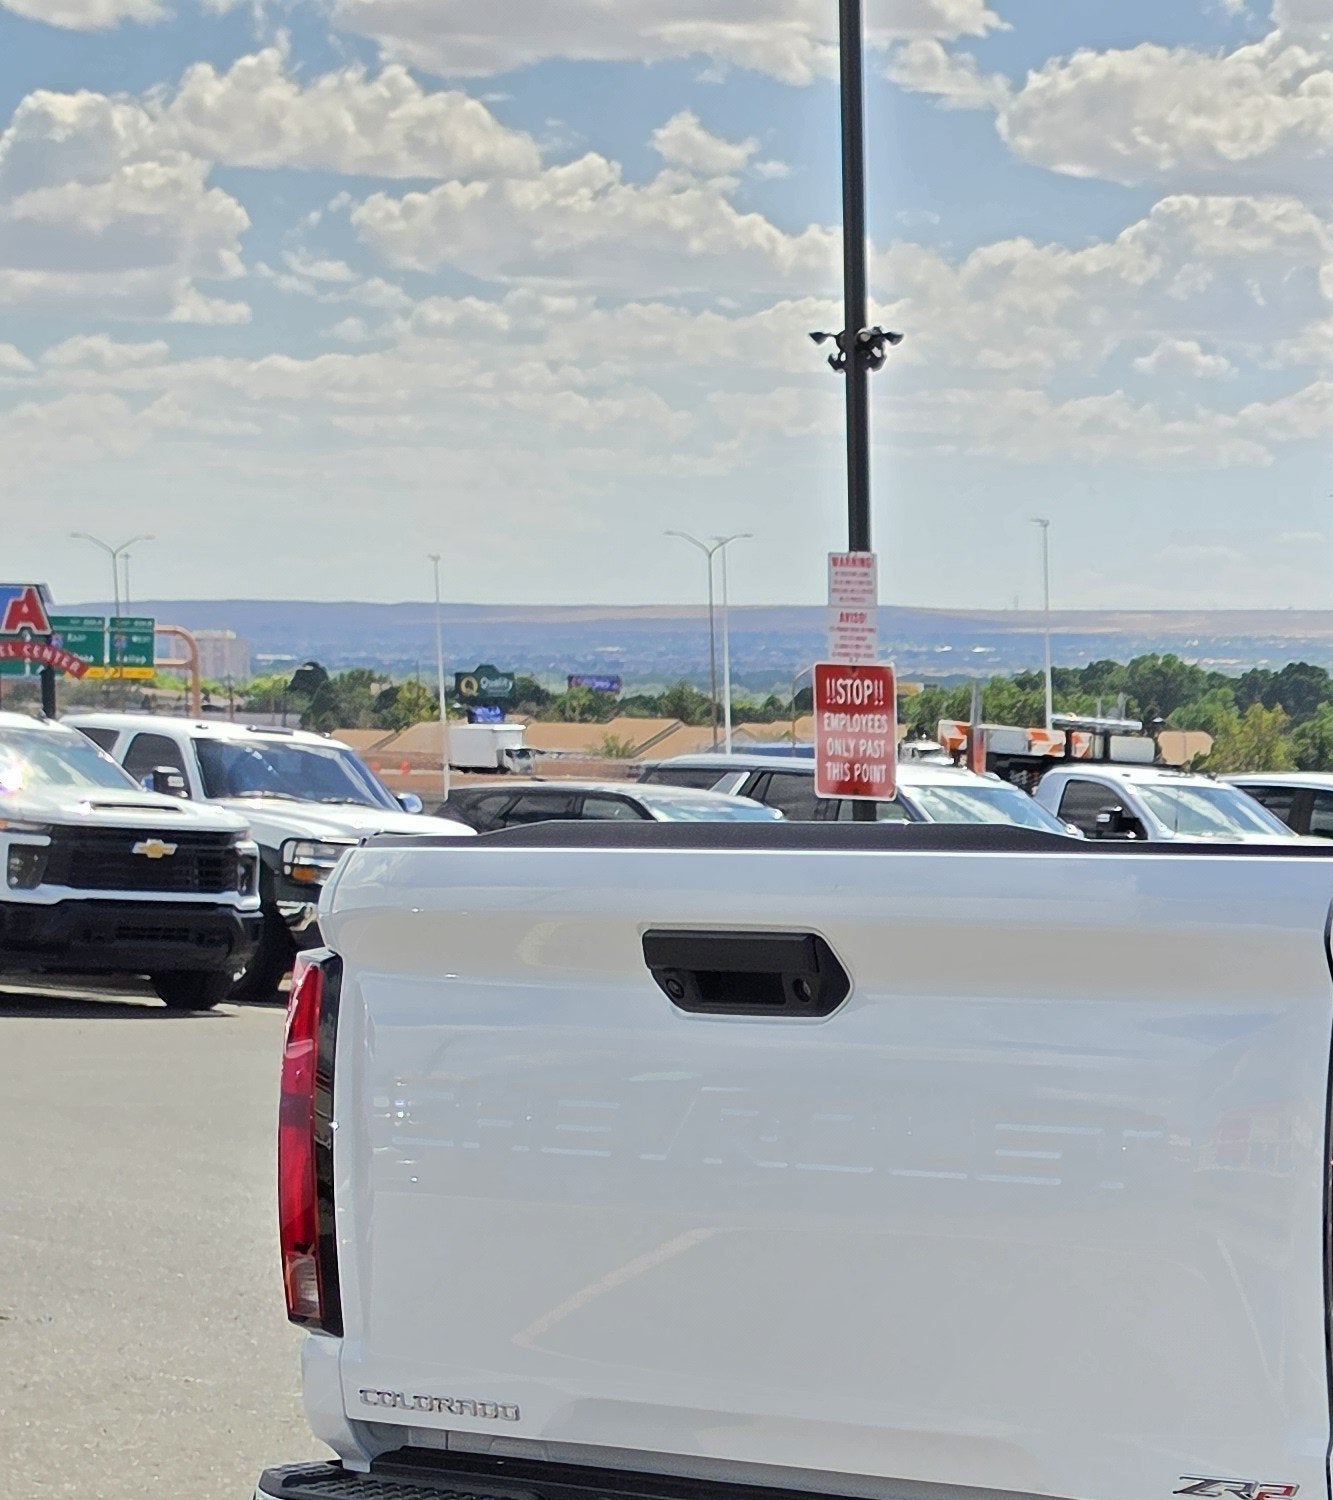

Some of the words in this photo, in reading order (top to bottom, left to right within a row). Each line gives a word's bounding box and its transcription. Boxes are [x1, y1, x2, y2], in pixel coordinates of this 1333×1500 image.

[22, 643, 81, 673] CENTER
[823, 712, 888, 733] EMPLOYEES
[826, 737, 855, 758] ONLY
[859, 739, 886, 759] PAST
[825, 761, 851, 782] THIS
[853, 763, 887, 783] POINT
[358, 1386, 521, 1422] COLORADO
